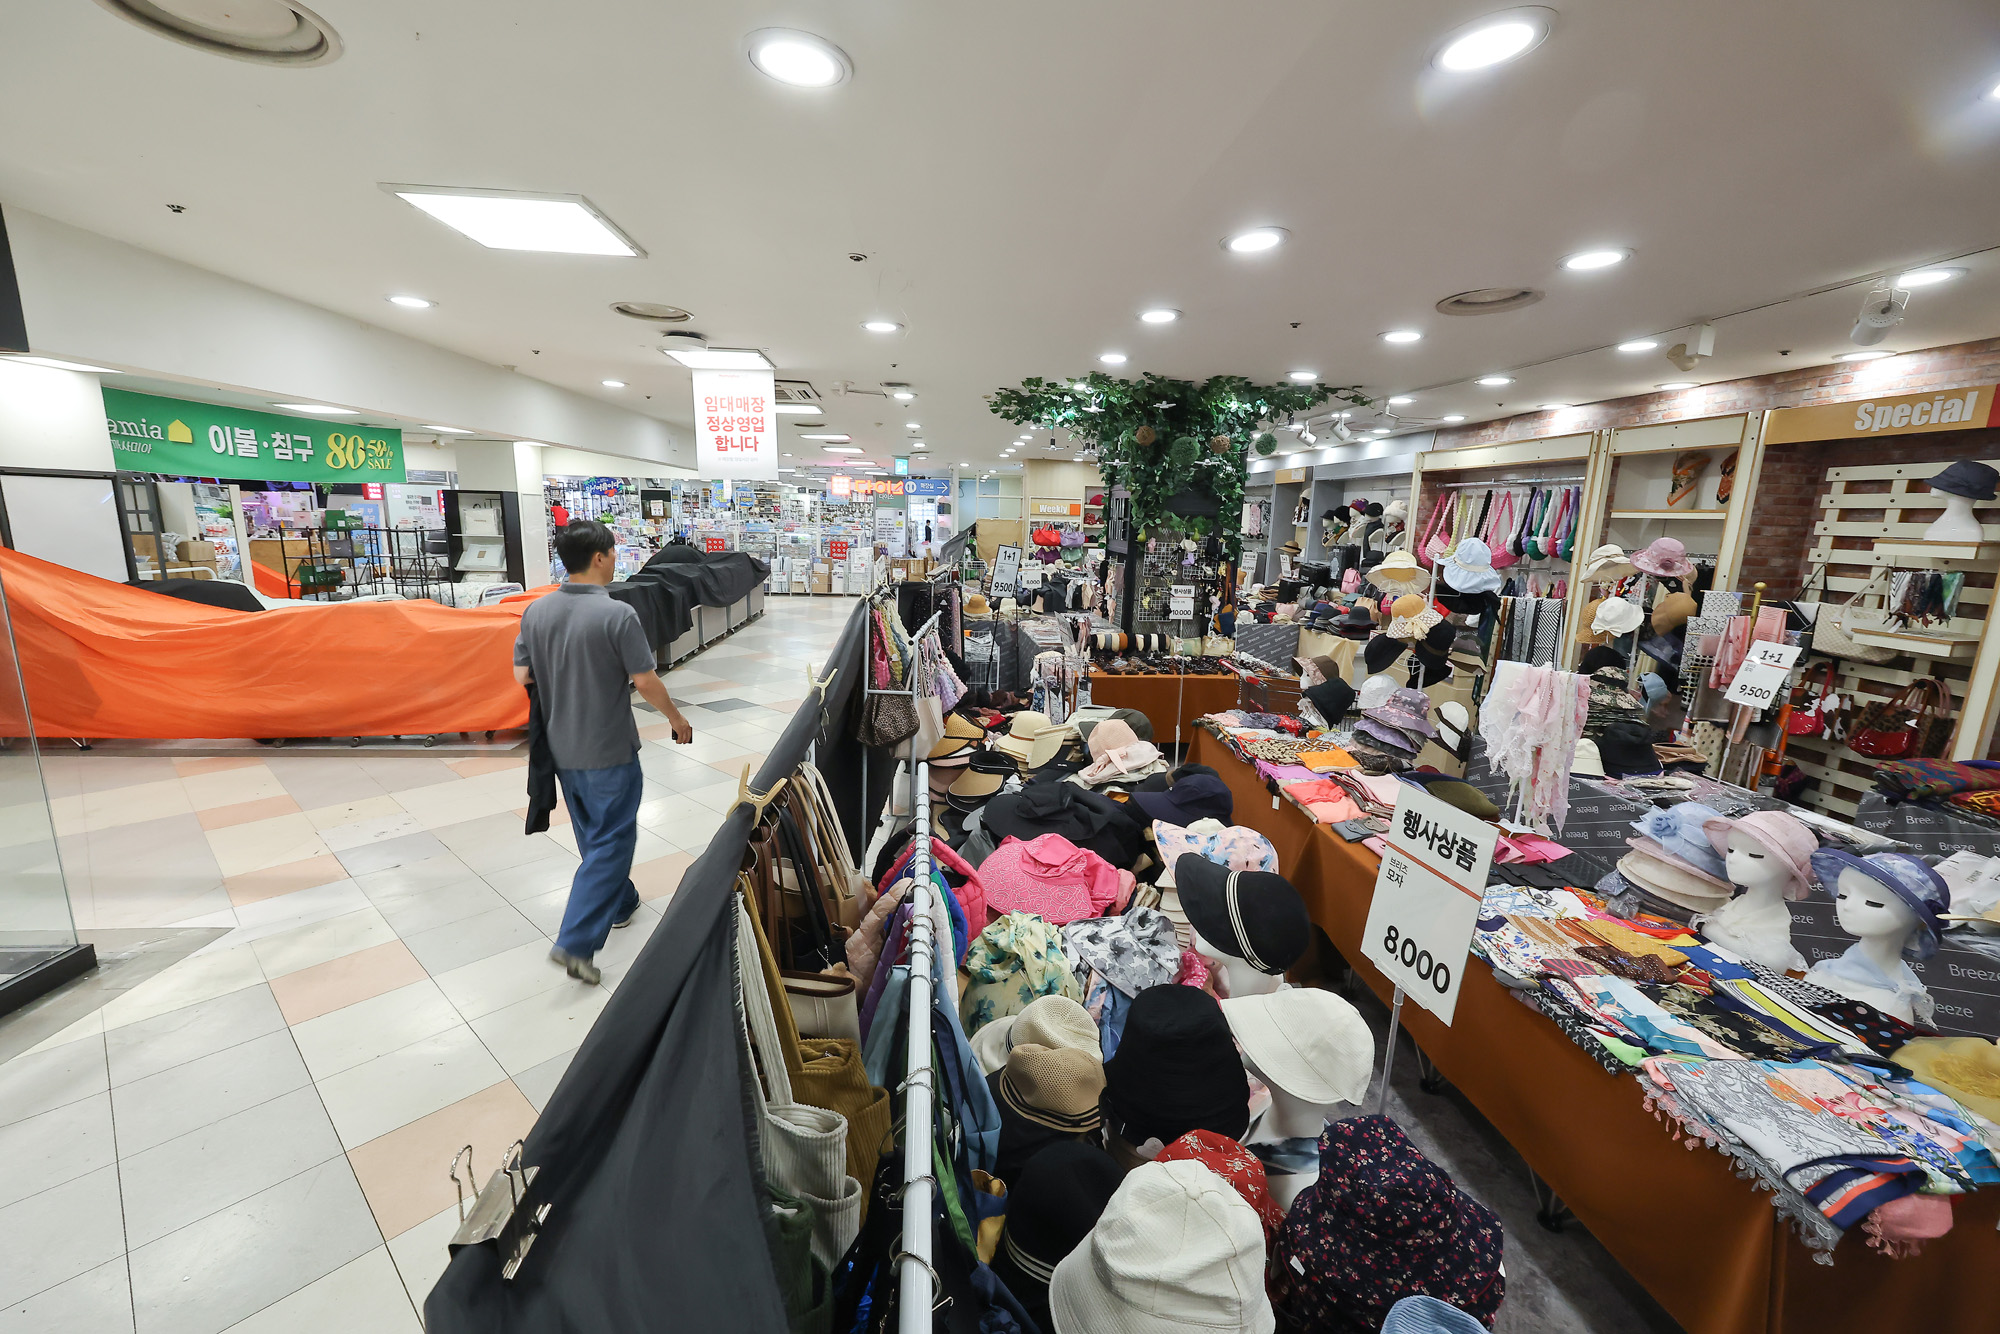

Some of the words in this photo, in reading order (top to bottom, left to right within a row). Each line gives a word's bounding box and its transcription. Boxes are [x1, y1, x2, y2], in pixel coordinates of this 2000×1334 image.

[704, 396, 765, 413] 임대매장
[1854, 391, 1978, 432] Special
[706, 416, 765, 432] 정상영업
[715, 435, 759, 452] 합니다
[367, 458, 392, 470] SALE
[854, 479, 904, 495] 다이소
[1039, 504, 1067, 515] Weekly
[1003, 550, 1016, 562] 1+1
[994, 581, 1013, 592] 9,500
[1760, 650, 1783, 664] 1+1
[1739, 684, 1771, 700] 9,500
[1609, 804, 1636, 812] Breeze
[1403, 808, 1478, 873] 행사상품
[1566, 831, 1589, 840] Breeze
[1389, 857, 1409, 875] 브리즈
[1386, 867, 1404, 888] 모자
[1383, 925, 1451, 994] 8,000
[1935, 1003, 1974, 1018] eeze
